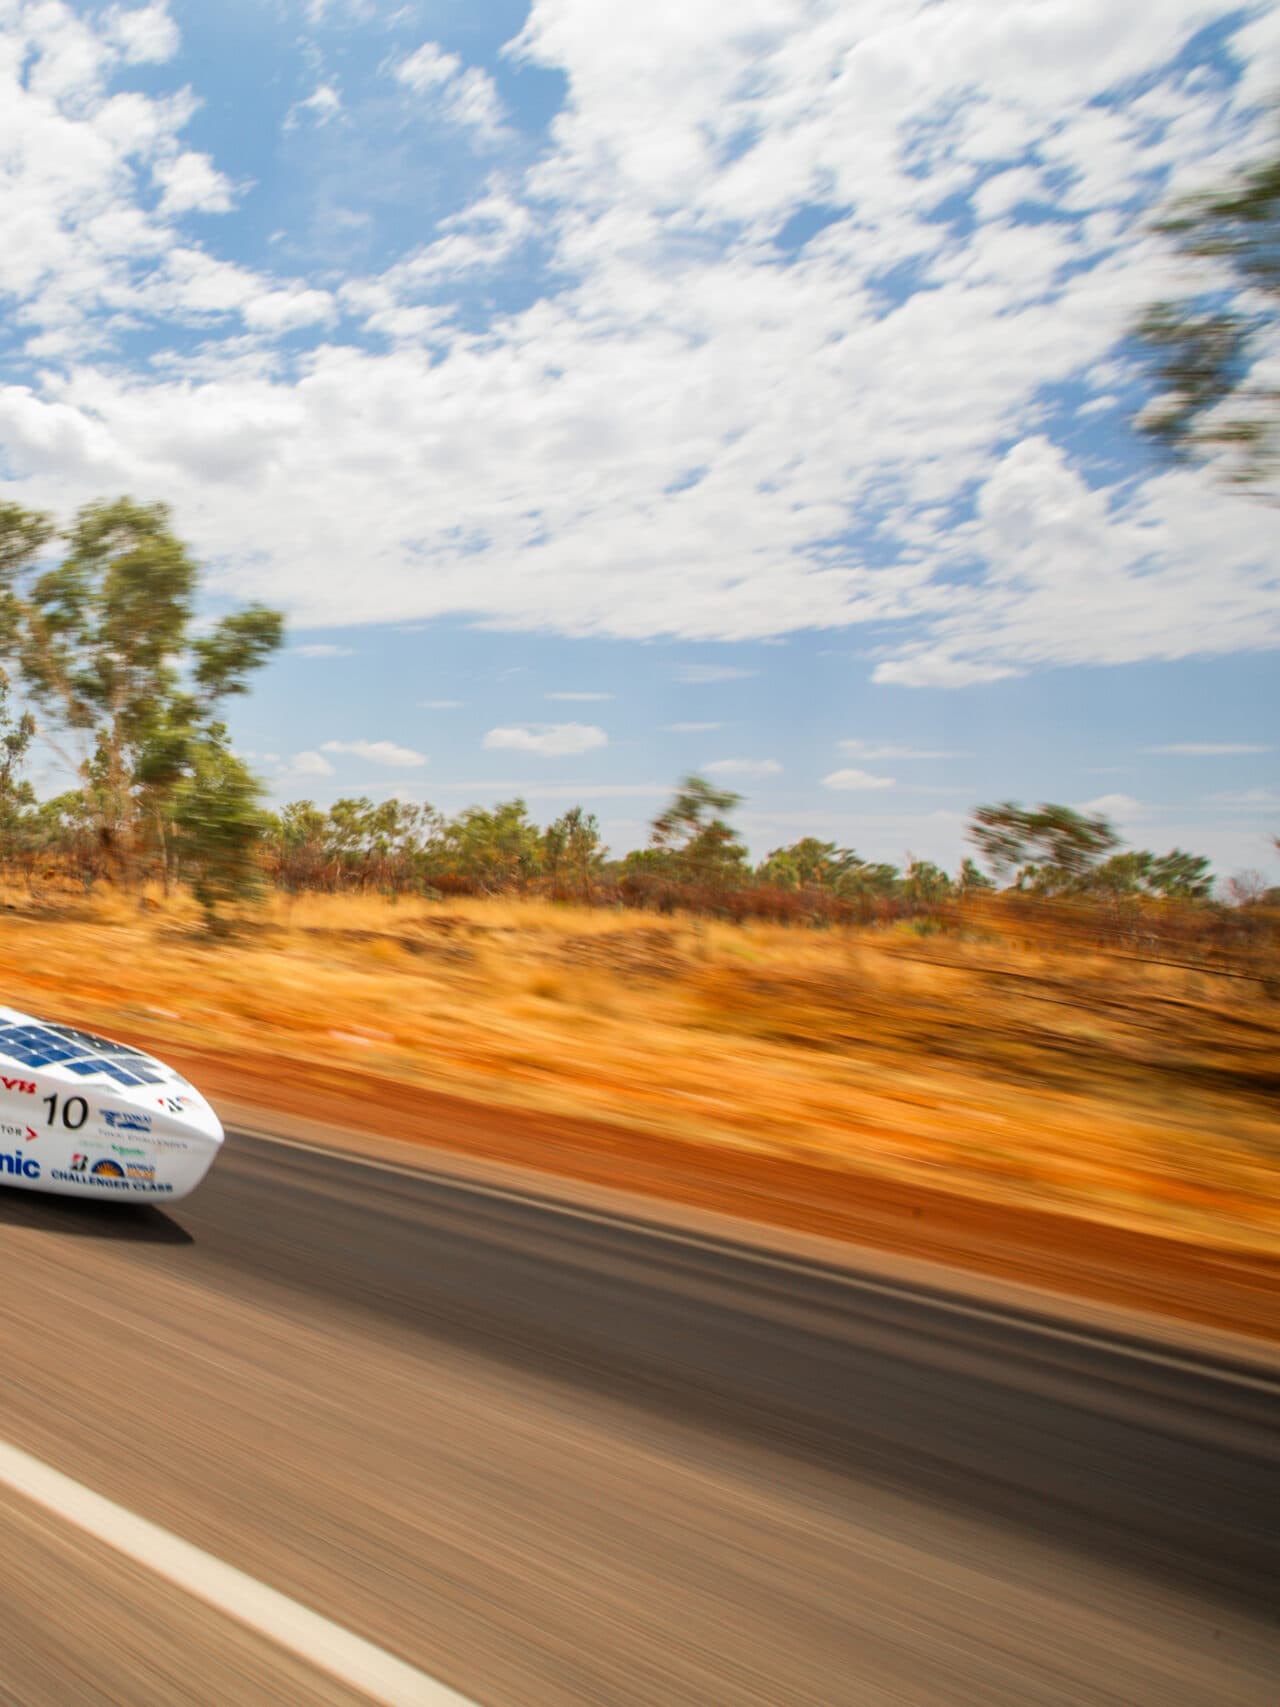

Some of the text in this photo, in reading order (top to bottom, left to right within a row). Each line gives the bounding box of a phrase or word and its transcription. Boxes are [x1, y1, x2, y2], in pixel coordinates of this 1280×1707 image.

[43, 1092, 89, 1130] 10
[51, 1168, 130, 1191] CHALLENGER
[132, 1182, 173, 1193] CLASS
